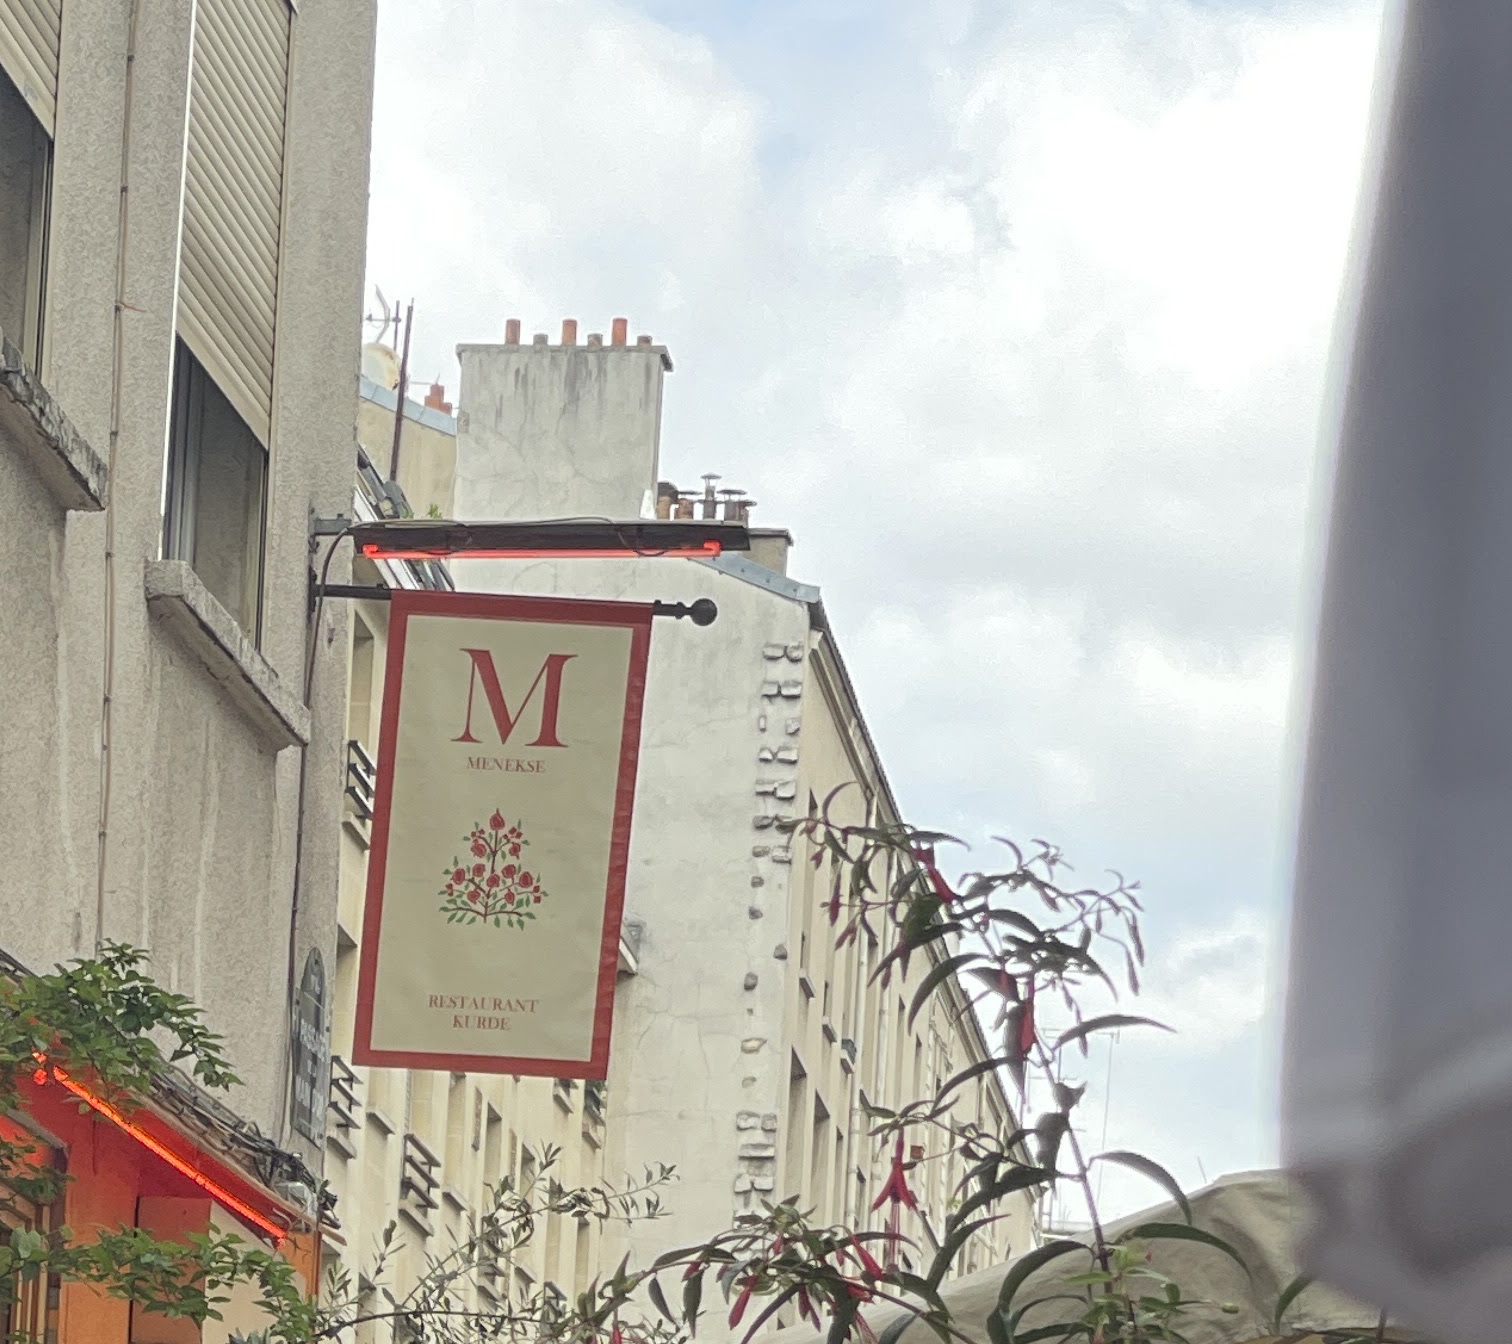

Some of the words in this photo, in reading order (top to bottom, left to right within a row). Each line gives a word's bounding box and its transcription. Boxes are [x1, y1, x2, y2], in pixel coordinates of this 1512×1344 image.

[450, 648, 578, 748] M
[468, 756, 546, 773] MENEKSE
[428, 994, 540, 1014] RESTAURANT
[452, 1014, 511, 1031] KURDE
